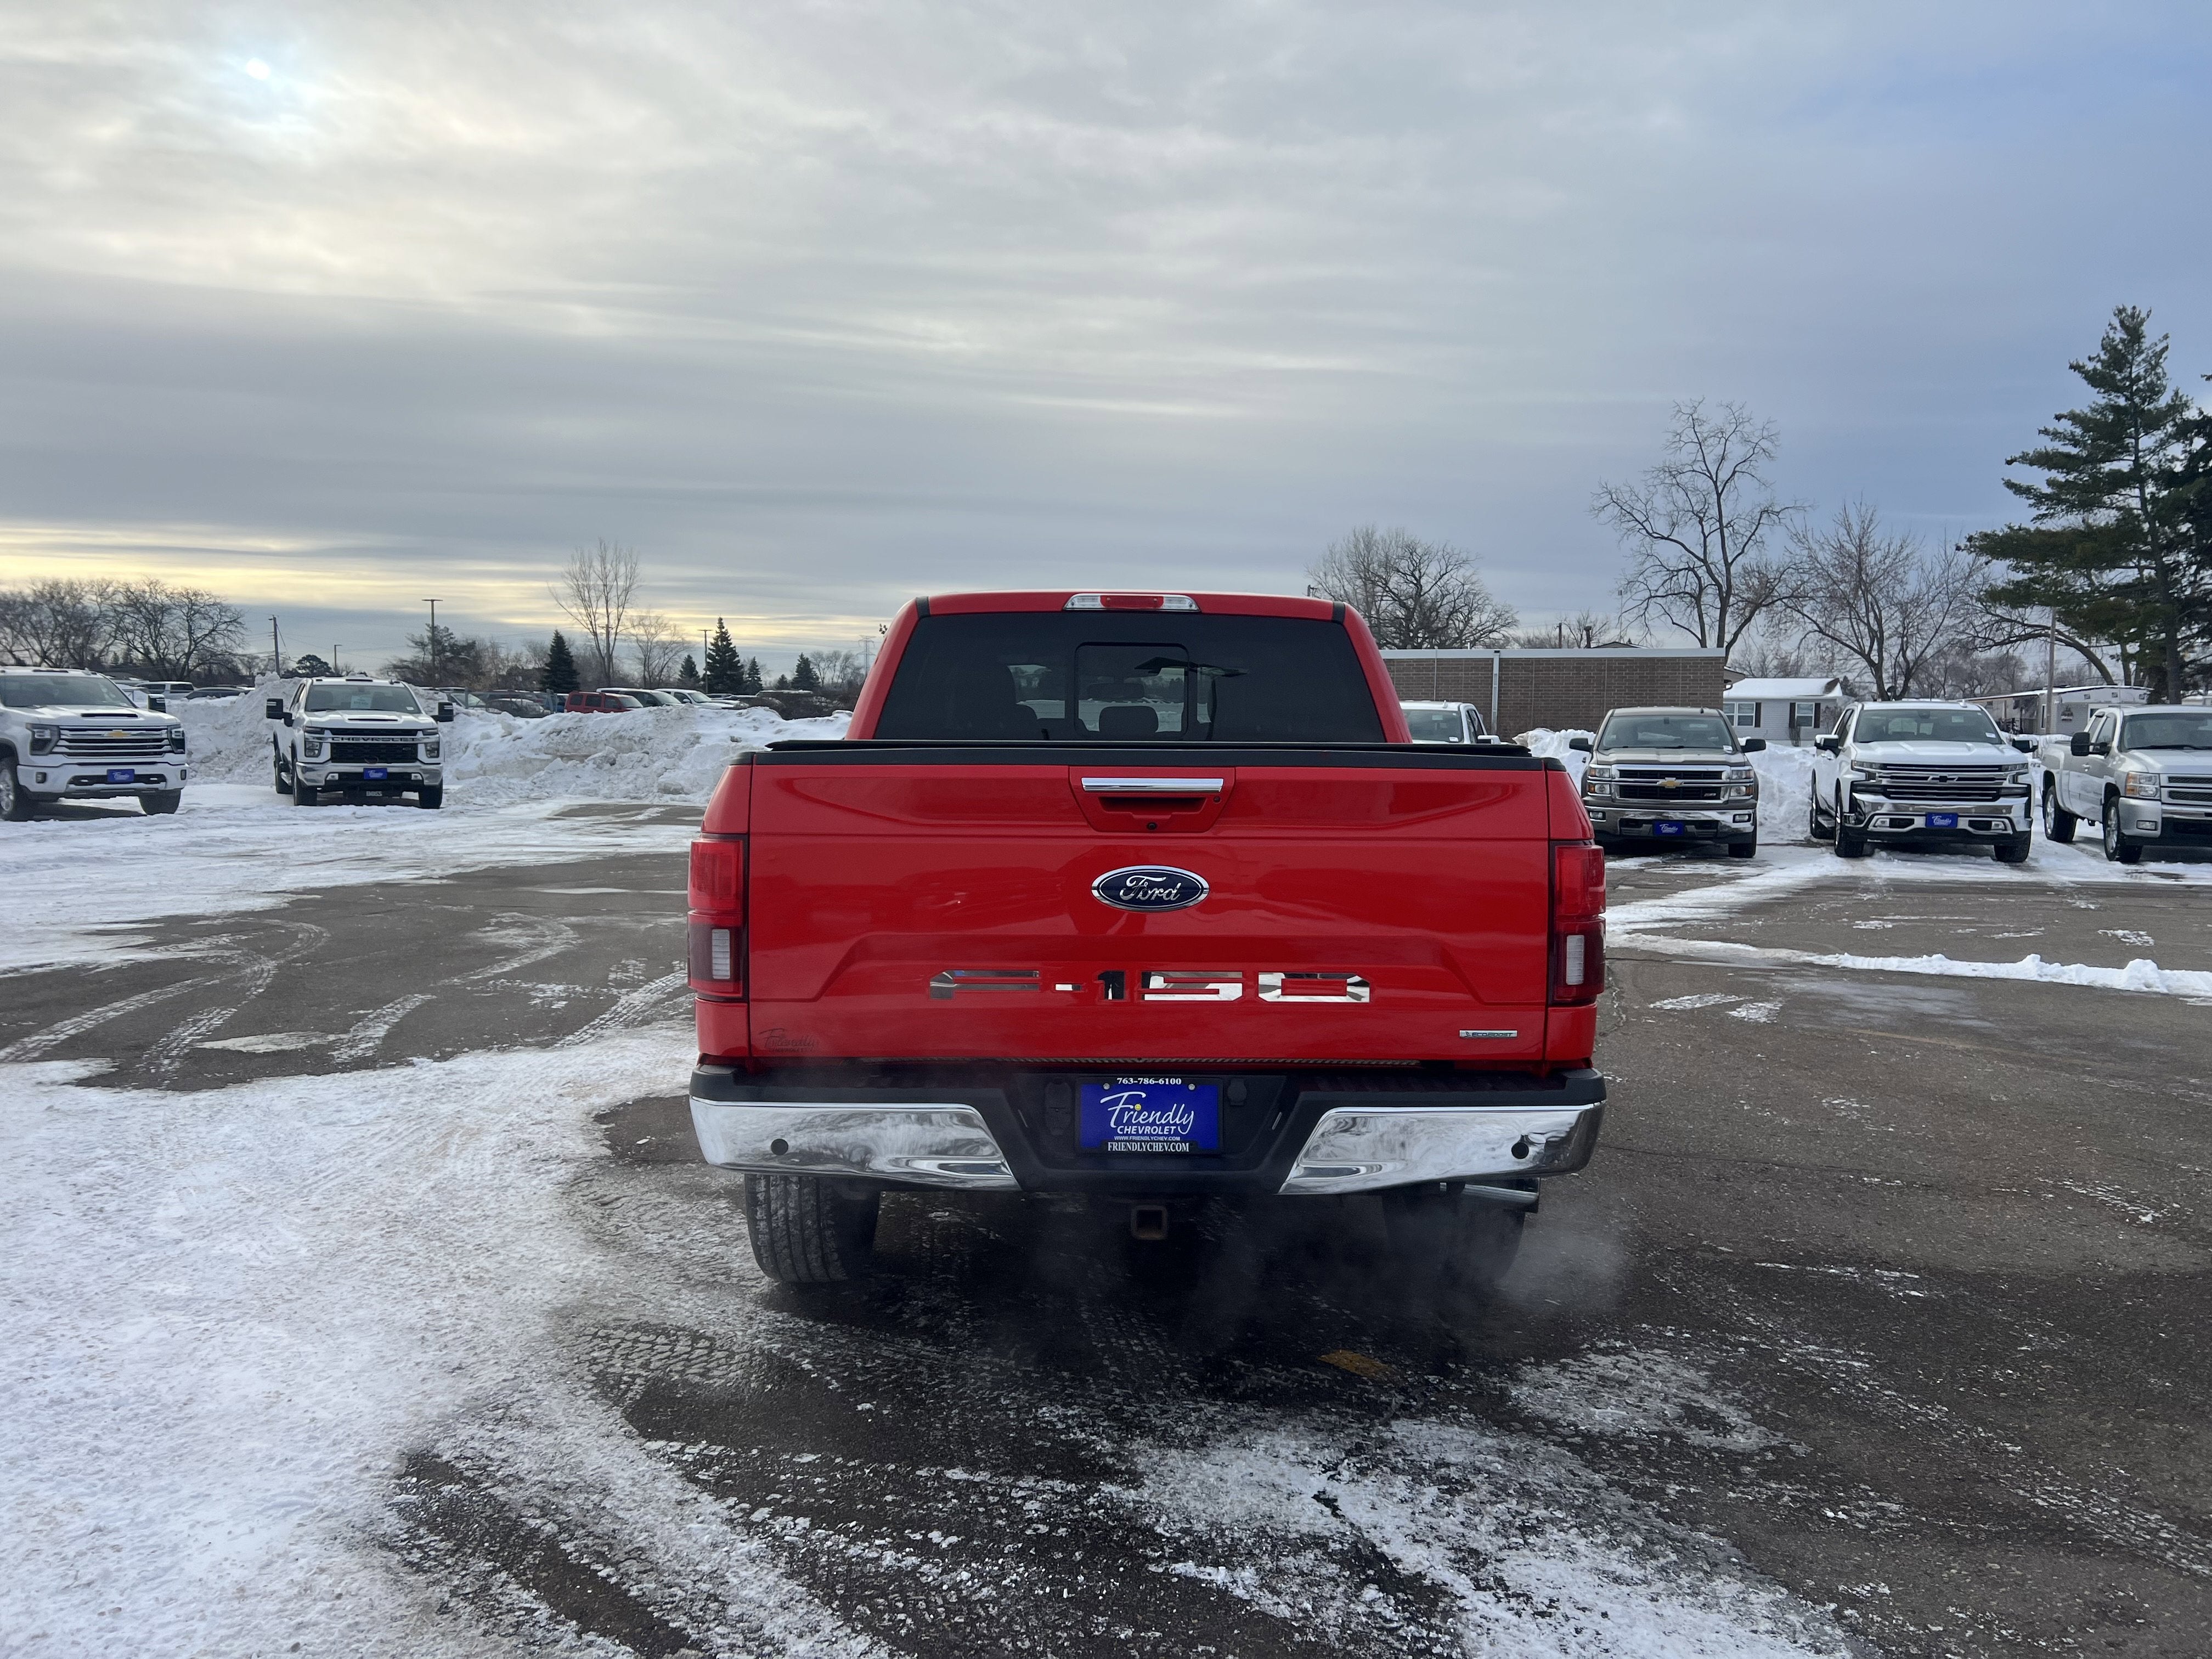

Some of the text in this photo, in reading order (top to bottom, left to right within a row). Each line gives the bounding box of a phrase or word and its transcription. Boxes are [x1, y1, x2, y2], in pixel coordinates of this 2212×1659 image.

[1119, 875, 1181, 902] Ford
[929, 970, 1372, 1002] F-150
[1100, 1091, 1194, 1135] Friendly
[1117, 1125, 1176, 1135] CHEVROLET
[1108, 1142, 1189, 1152] FRIENDLYCHEV.COM
